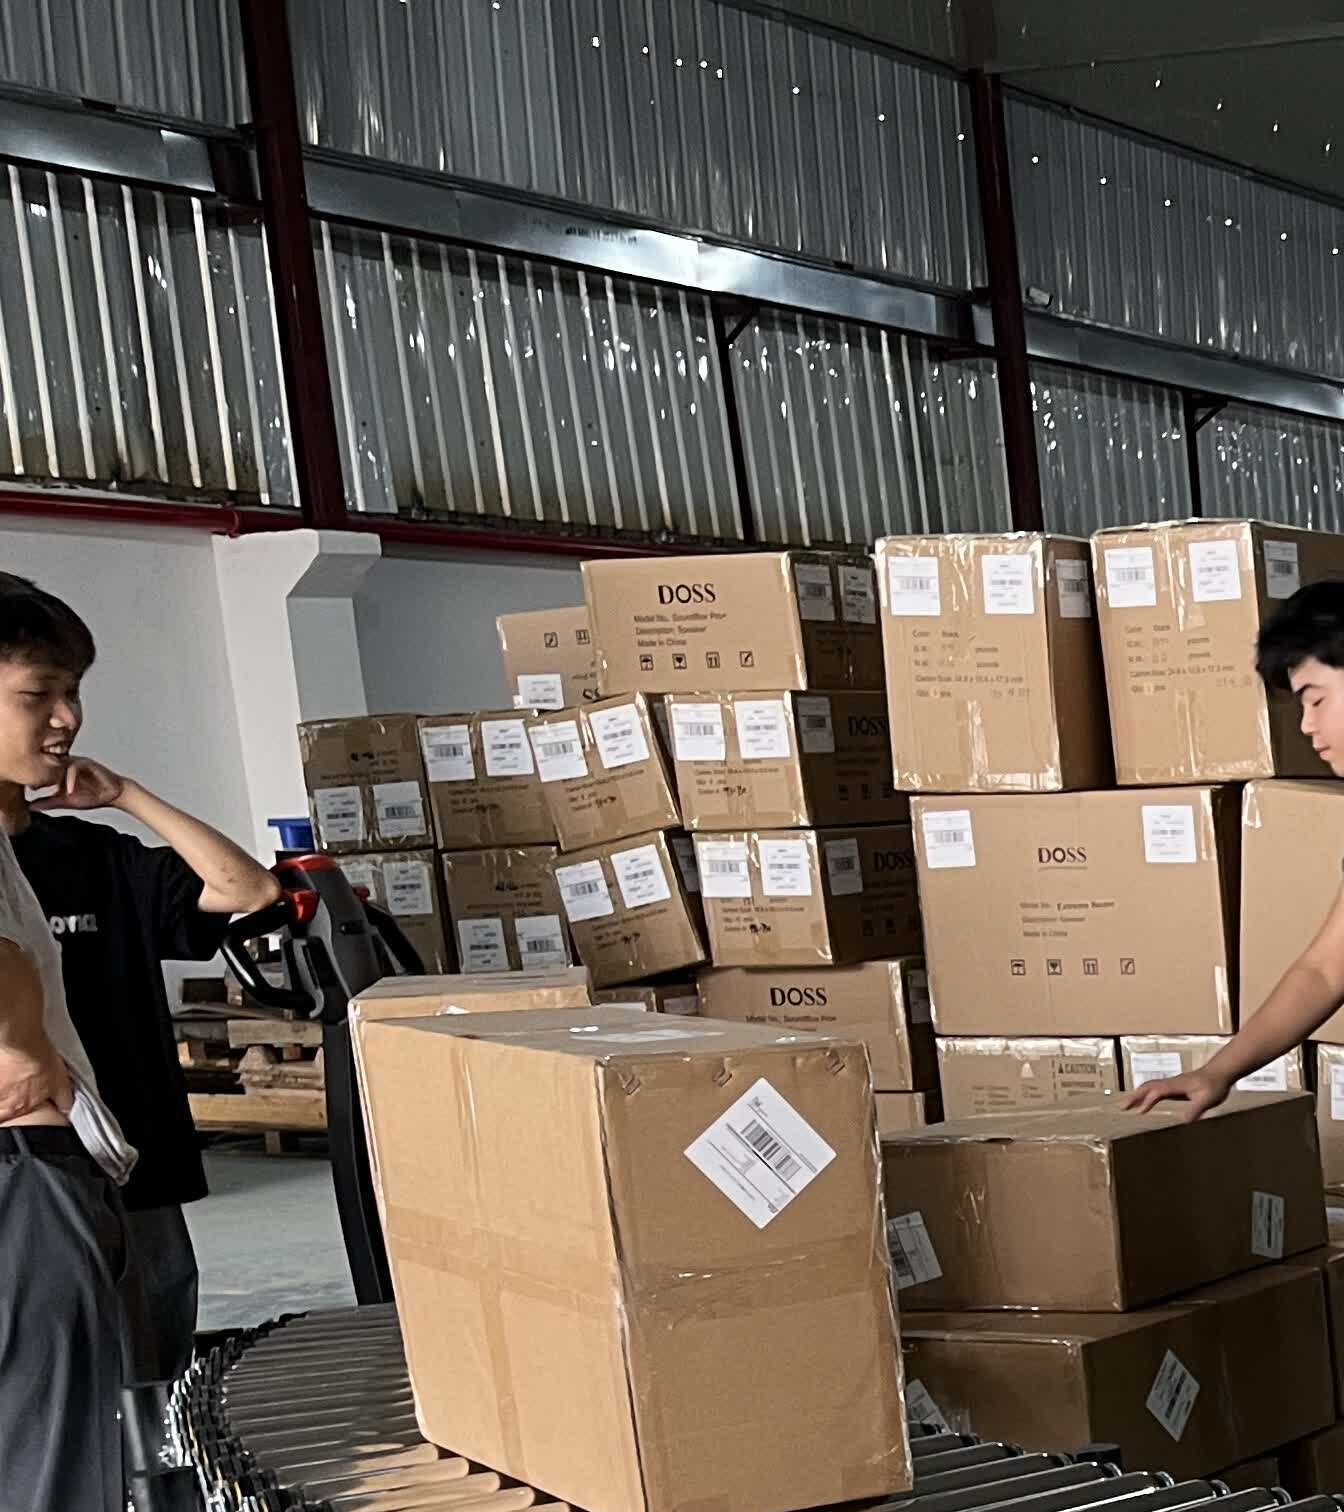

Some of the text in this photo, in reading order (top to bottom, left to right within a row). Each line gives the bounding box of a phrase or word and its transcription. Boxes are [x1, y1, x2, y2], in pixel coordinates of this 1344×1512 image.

[657, 583, 716, 604] DOSS
[1038, 847, 1087, 864] DOSS
[769, 987, 828, 1007] DOSS
